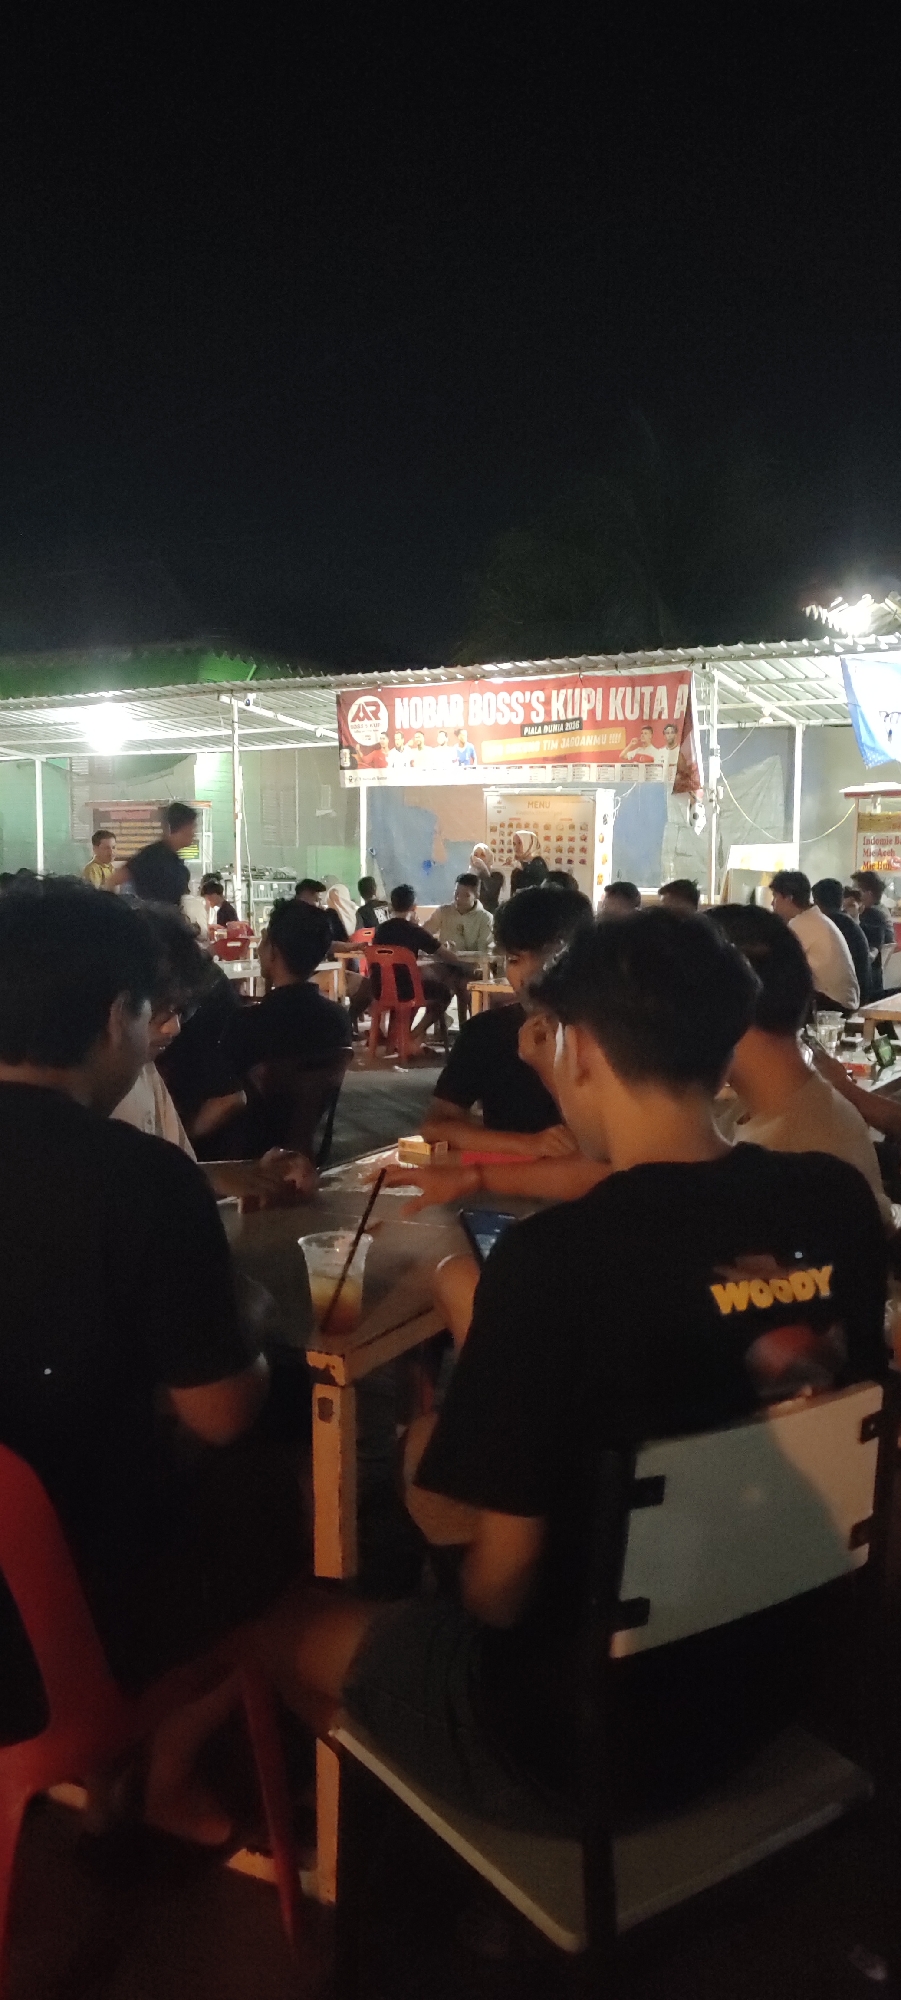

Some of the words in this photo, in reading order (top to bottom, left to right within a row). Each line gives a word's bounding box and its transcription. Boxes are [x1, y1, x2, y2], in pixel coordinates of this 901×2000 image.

[395, 694, 465, 729] NOBAR
[468, 690, 545, 727] BOSS'S
[551, 687, 603, 721] KUPI
[608, 685, 669, 720] KUTA
[523, 726, 542, 736] PIALA
[543, 723, 564, 734] DUNIA
[565, 720, 580, 731] 2026
[543, 739, 558, 750] TIM
[527, 801, 550, 809] MENU
[863, 836, 892, 845] Indomie
[863, 848, 875, 857] Mie
[877, 848, 895, 857] Aceh
[709, 1264, 834, 1316] WOODY
